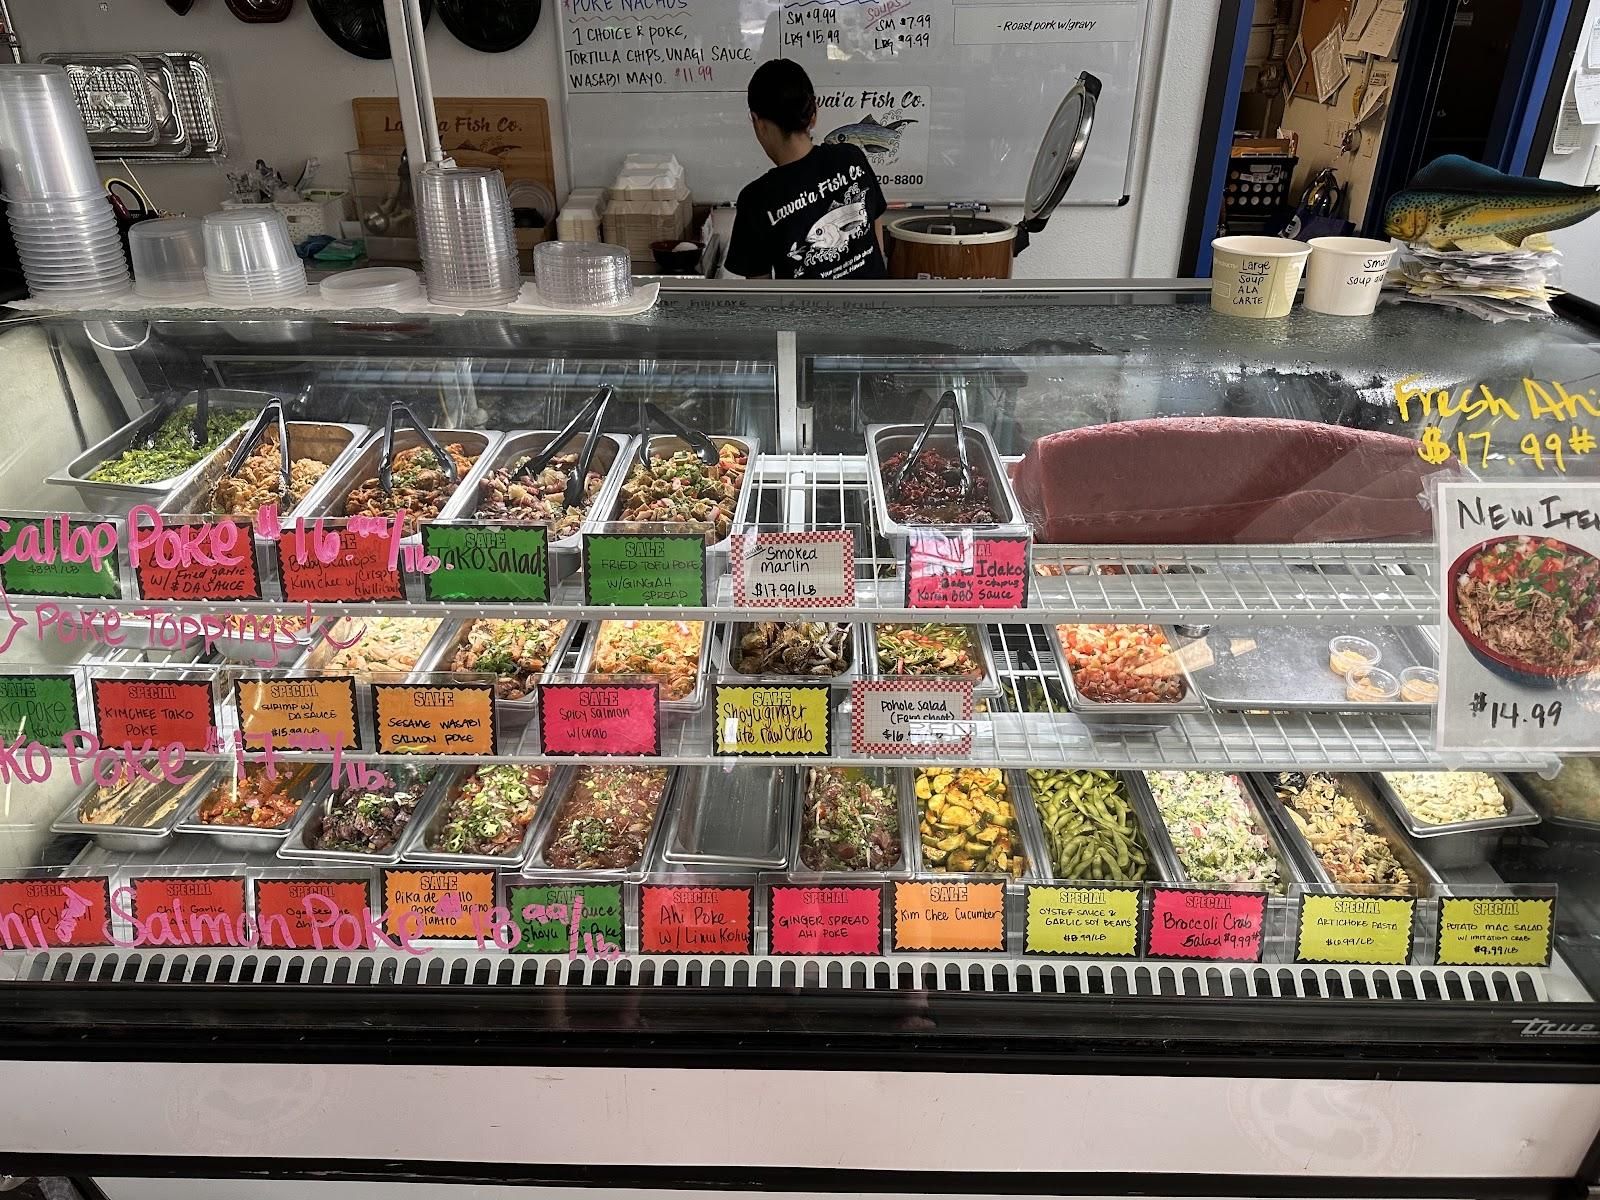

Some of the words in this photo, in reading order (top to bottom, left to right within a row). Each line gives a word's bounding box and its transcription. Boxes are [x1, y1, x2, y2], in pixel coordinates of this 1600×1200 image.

[786, 11, 805, 26] SM
[806, 8, 836, 24] $9.99
[876, 19, 896, 31] SM
[900, 14, 931, 29] $7.99
[1003, 20, 1033, 31] Roast
[1033, 20, 1056, 32] pork
[1057, 18, 1096, 31] w/gravy
[573, 28, 583, 45] 1
[587, 28, 632, 41] CHOICE
[784, 32, 803, 48] LRG
[807, 29, 840, 44] $15.99
[898, 33, 930, 48] $9.99
[566, 50, 621, 66] TORTILLA
[667, 49, 704, 64] UNAGI
[570, 73, 620, 88] WASABI
[860, 91, 895, 109] Fish
[901, 91, 925, 109] Co.
[455, 116, 491, 133] Fish
[497, 116, 523, 133] Co.
[767, 191, 819, 226] Lawai'a
[817, 172, 848, 199] Fish
[849, 165, 866, 181] Co.
[1242, 260, 1271, 274] Large
[1239, 275, 1264, 285] Soup
[1394, 372, 1521, 422] Fresh
[0, 513, 118, 573] callop
[128, 504, 245, 569] Poke
[465, 532, 507, 549] SALE
[625, 541, 665, 558] SALE
[766, 546, 818, 560] Smoked
[488, 546, 542, 577] Salad
[601, 559, 638, 570] FRIED
[641, 560, 671, 570] TOFU
[672, 559, 700, 570] POKE
[976, 559, 1022, 578] Idako
[176, 570, 207, 580] Fried
[210, 567, 245, 583] garlic
[183, 582, 200, 593] DA
[203, 581, 244, 592] SAUCE
[607, 578, 672, 590] W/GINGAH
[941, 578, 973, 588] Baby
[642, 591, 688, 600] SPREAD
[917, 586, 948, 601] Korean
[36, 601, 128, 645] Poke
[128, 687, 176, 699] SPECIAL
[271, 685, 318, 698] SPECIAL
[579, 691, 618, 706] SALE
[414, 691, 454, 707] SALE
[753, 692, 791, 706] SALE
[105, 707, 156, 718] KIMCHEE
[304, 710, 336, 719] SAUCE
[559, 707, 587, 722] Spicy
[724, 703, 761, 727] Shoyu
[762, 704, 807, 728] ginger
[1470, 691, 1562, 728] $14.99
[126, 724, 158, 735] POKE
[387, 718, 432, 729] SESAME
[440, 719, 481, 729] WASABI
[392, 734, 436, 744] SALMON
[445, 734, 474, 744] POKE
[785, 723, 813, 742] crab
[62, 730, 193, 786] Poke
[167, 884, 212, 896] SPECIAL
[421, 876, 457, 890] SALE
[289, 886, 335, 897] SPECIAL
[424, 892, 438, 902] de
[673, 892, 718, 903] SPECIAL
[803, 892, 848, 904] SPECIAL
[930, 887, 967, 902] SALE
[1060, 891, 1106, 904] SPECIAL
[191, 905, 224, 913] Garlic
[1185, 896, 1231, 909] SPECIAL
[1335, 901, 1380, 914] SPECIAL
[1474, 903, 1519, 915] SPECIAL
[102, 886, 297, 947] Salmon
[301, 893, 434, 956] Poke
[660, 905, 684, 925] Ahi
[695, 907, 725, 923] Poke
[901, 910, 920, 921] Kim
[925, 909, 949, 921] Chee
[955, 908, 1001, 920] Cucumber
[1163, 912, 1219, 929] Broccoli
[1223, 914, 1252, 929] Crab
[779, 916, 824, 929] GINGER
[828, 916, 869, 926] SPREAD
[1046, 918, 1082, 926] GARLIC
[1317, 918, 1368, 927] ARTICHOKE
[521, 925, 558, 942] Shoyu
[799, 929, 817, 938] AHI
[823, 928, 848, 937] POKE
